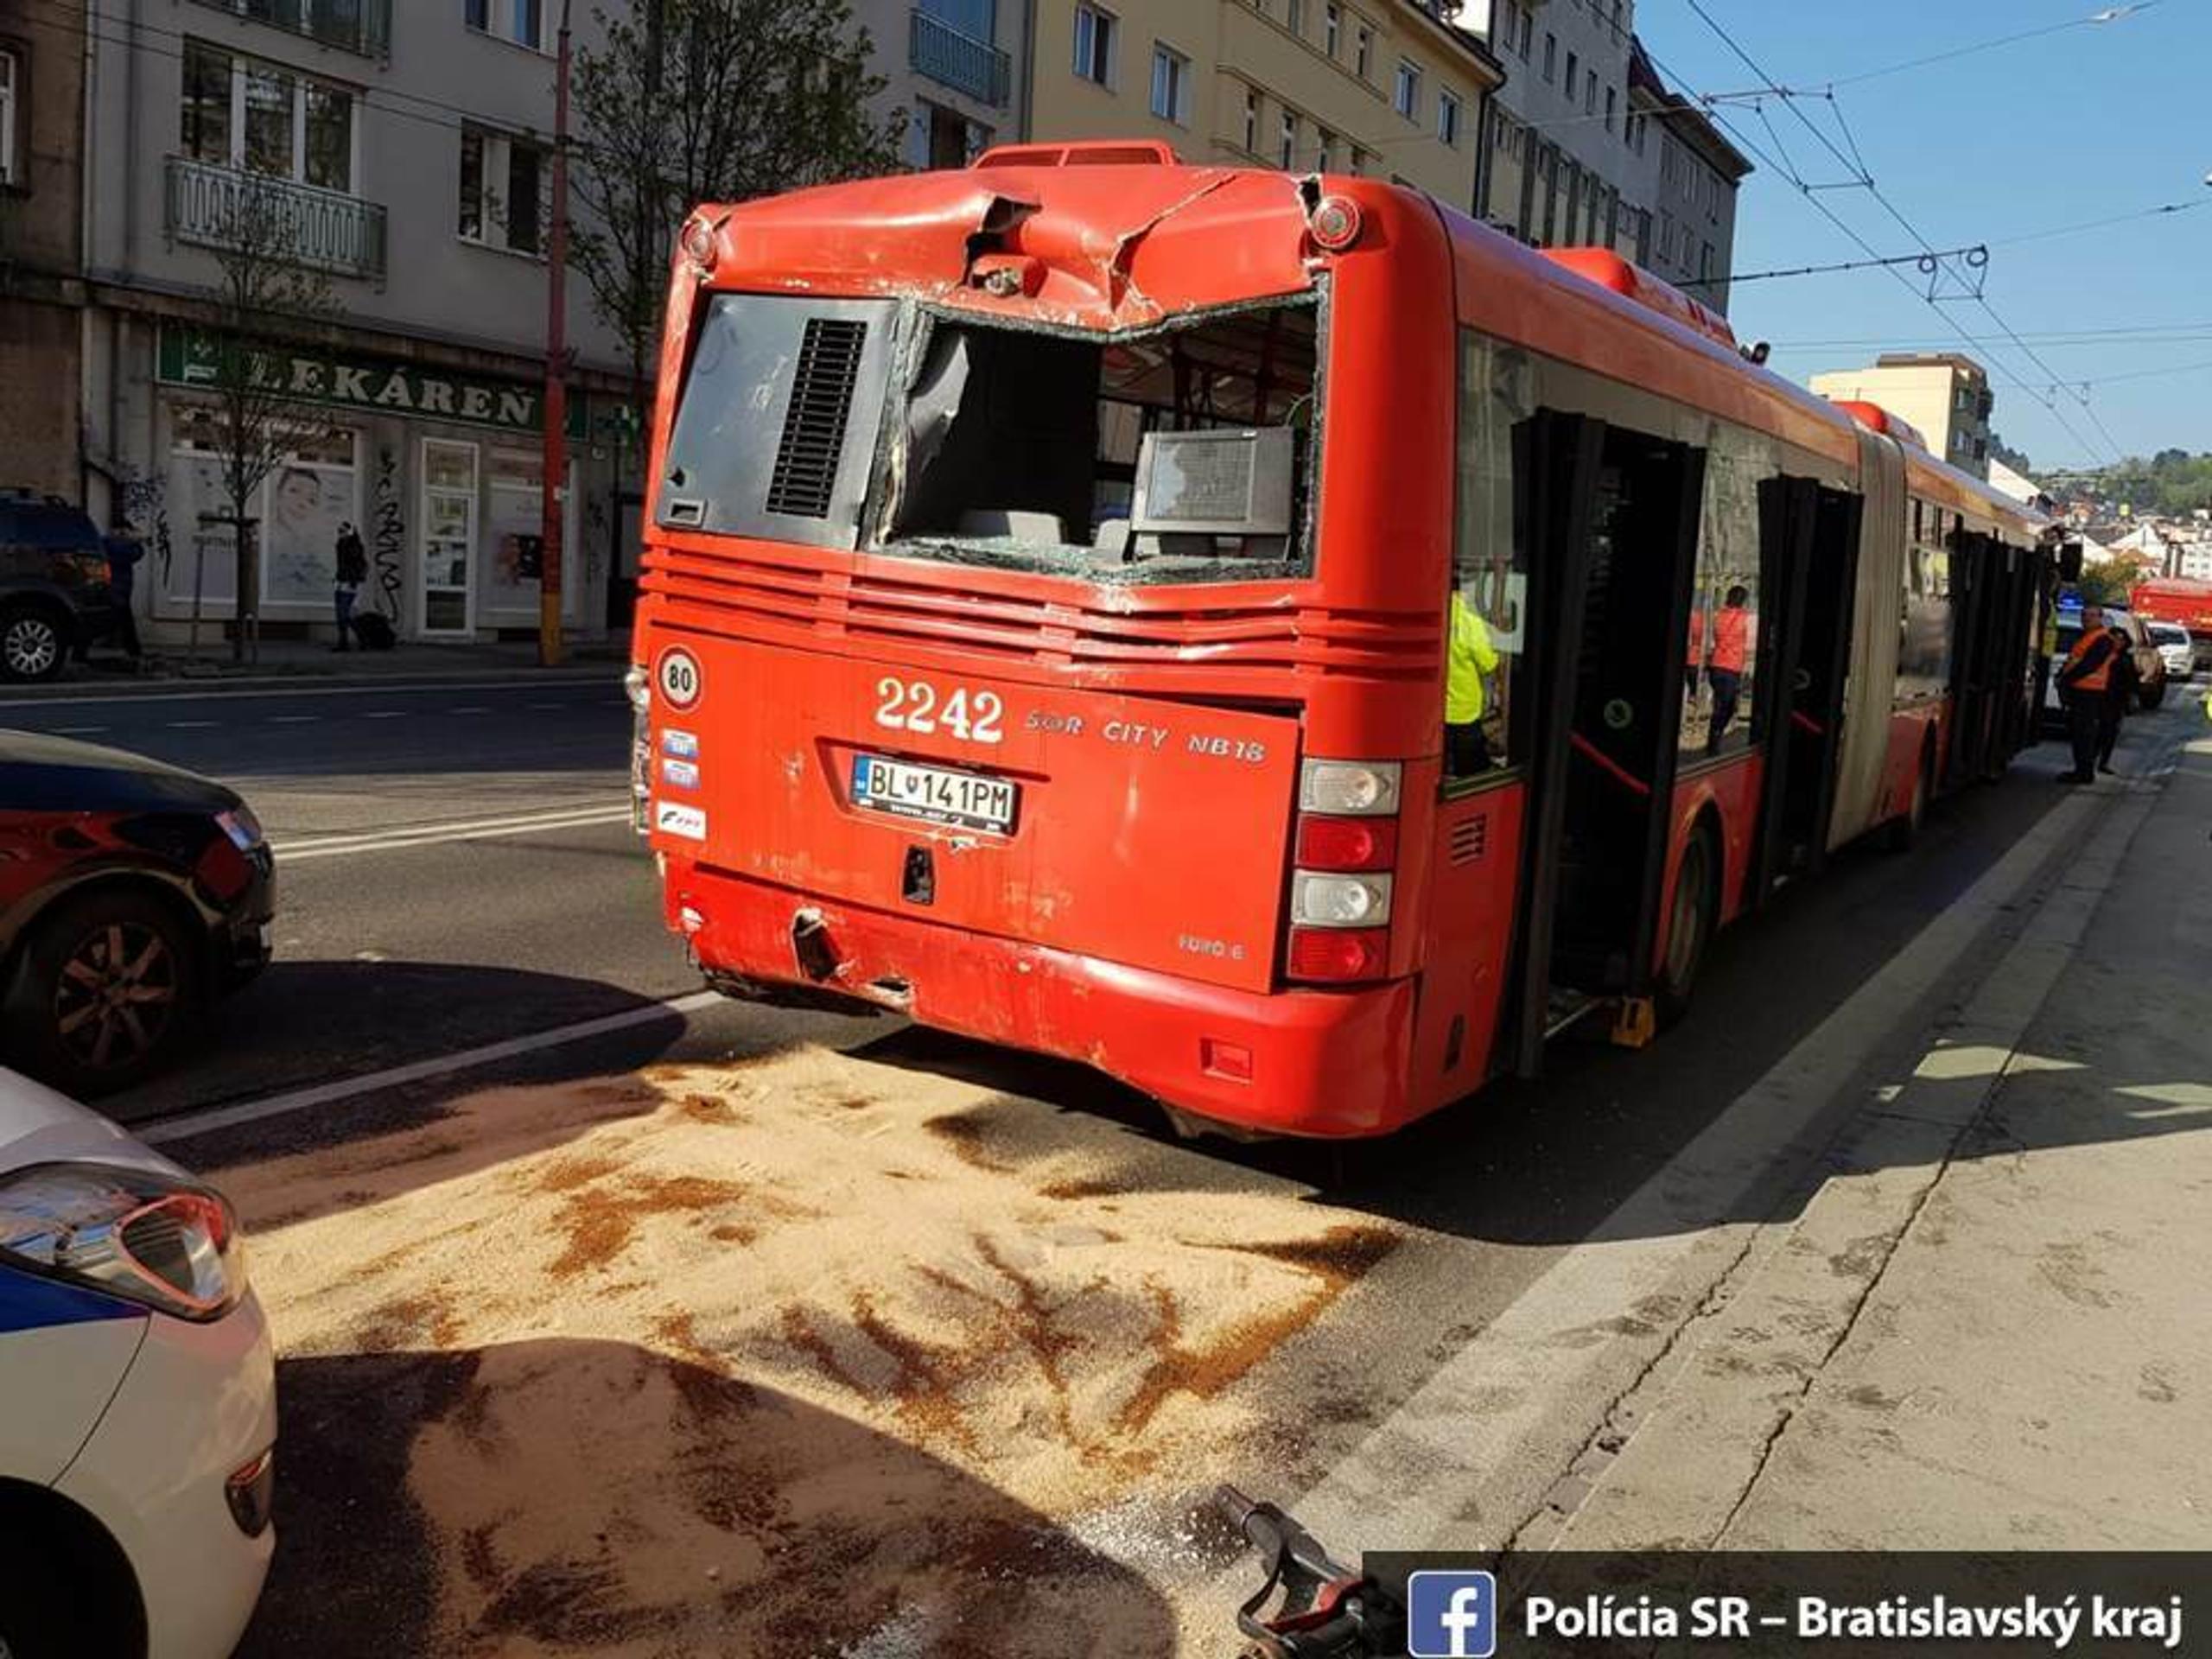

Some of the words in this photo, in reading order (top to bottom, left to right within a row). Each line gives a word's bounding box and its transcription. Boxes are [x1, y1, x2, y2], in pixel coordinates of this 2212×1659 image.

[247, 352, 537, 425] LEKÁREŇ
[669, 664, 692, 692] 80
[874, 677, 1003, 743] 2242
[1103, 721, 1168, 748] CITY
